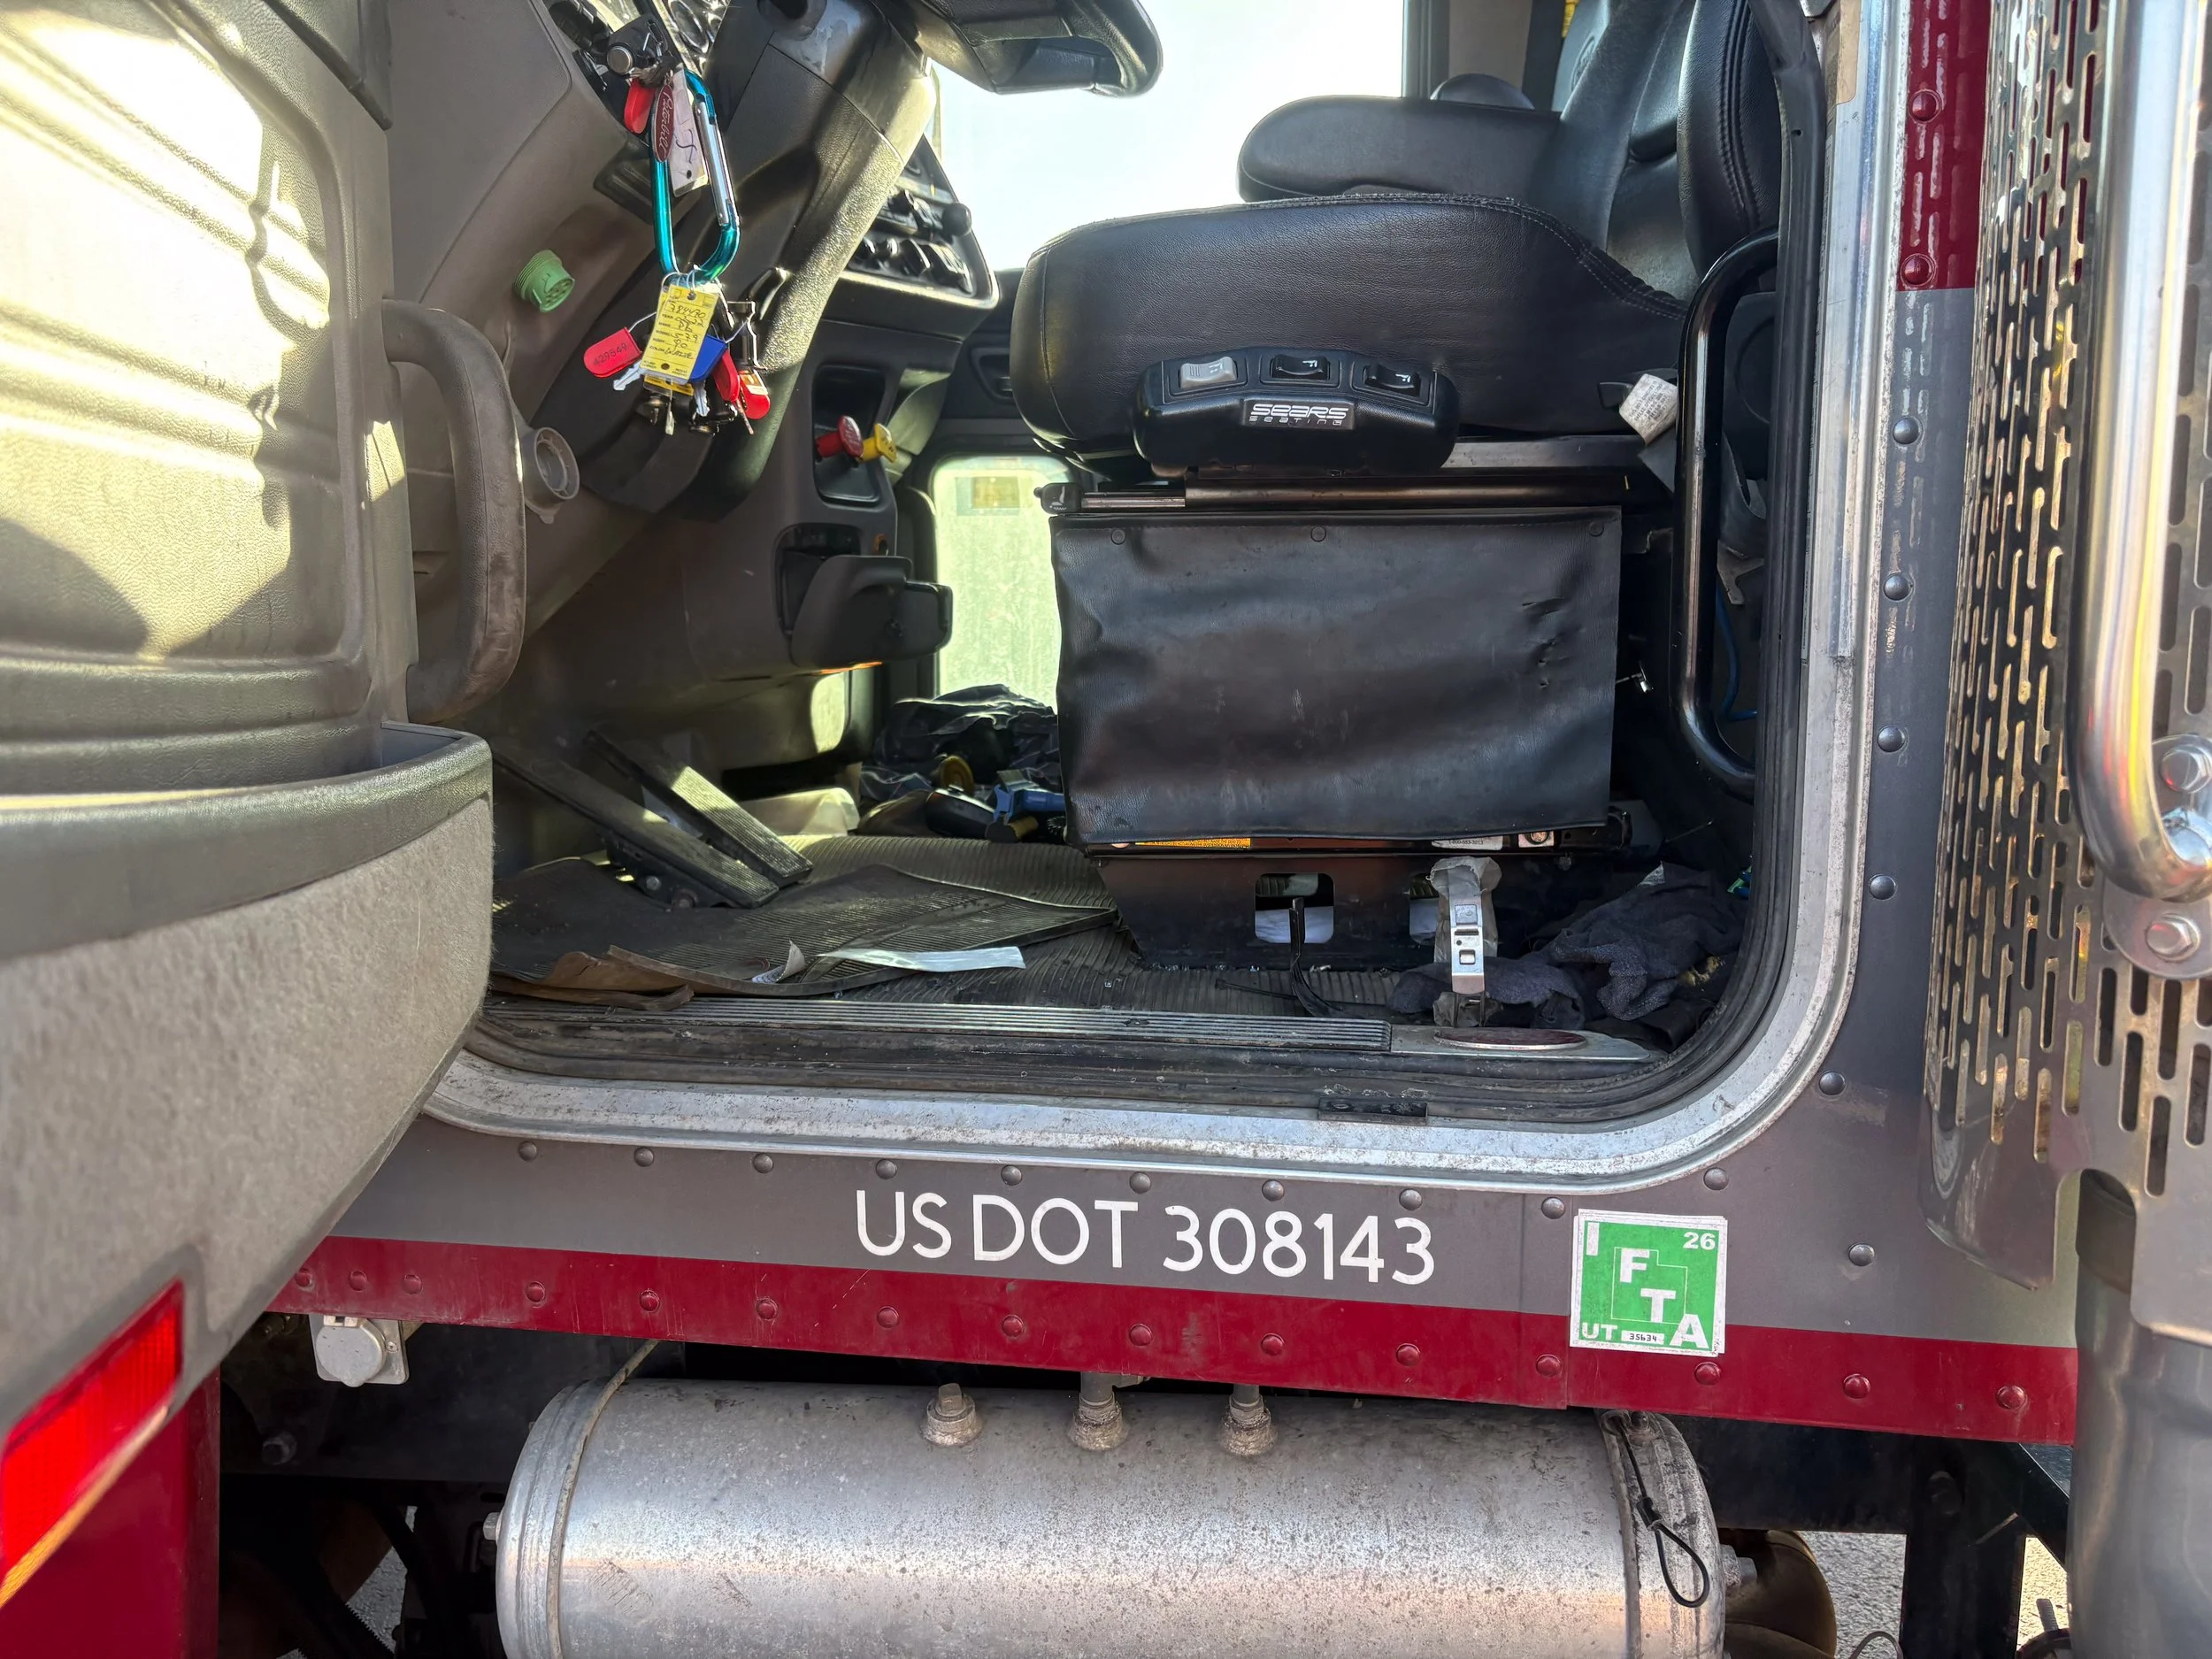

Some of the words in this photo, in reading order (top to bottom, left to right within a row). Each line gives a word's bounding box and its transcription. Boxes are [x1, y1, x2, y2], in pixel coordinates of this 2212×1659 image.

[1251, 403, 1349, 419] SEARS
[856, 1189, 953, 1259] US
[972, 1194, 1139, 1268] DOT
[1164, 1204, 1436, 1286] 308143
[1683, 1232, 1716, 1250] 26
[1582, 1322, 1618, 1341] UT
[1629, 1333, 1658, 1342] 35634
